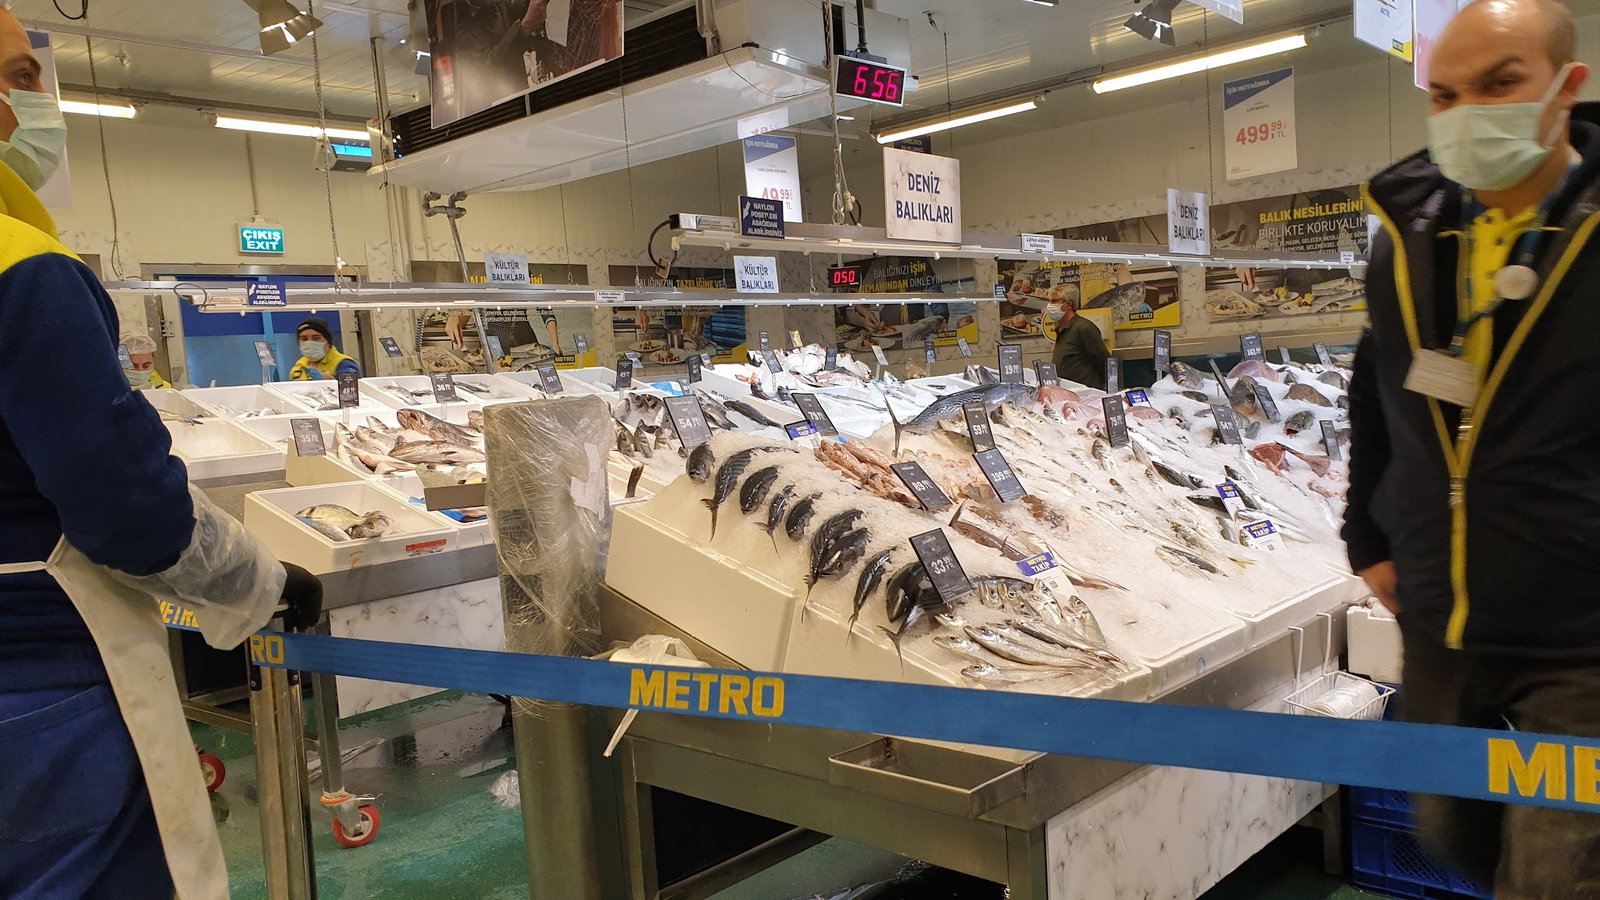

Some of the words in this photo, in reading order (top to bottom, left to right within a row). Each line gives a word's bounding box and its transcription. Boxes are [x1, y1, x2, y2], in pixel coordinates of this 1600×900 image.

[908, 171, 940, 194] DENİZ
[896, 200, 953, 224] BALIKLARI
[1180, 203, 1199, 221] DENİZ
[1259, 209, 1291, 224] BALIK
[1293, 197, 1364, 219] NESİLLERİNİ
[242, 230, 281, 242] ÇIKIŞ
[1174, 224, 1206, 242] BALIKLARI
[247, 241, 279, 250] EXIT
[495, 260, 520, 270] KÜLTÜR
[744, 264, 769, 276] KÜLTÜR
[873, 265, 909, 279] BALIĞINIZI
[910, 261, 926, 276] İŞİN
[492, 273, 526, 282] BALIKLARI
[676, 277, 714, 289] TAZELİĞİNE
[833, 270, 855, 284] 050
[909, 274, 944, 288] DİNLEYİN
[741, 280, 775, 290] BALIKLARI
[931, 559, 947, 575] 33
[1030, 562, 1051, 573] TAKİP
[629, 668, 785, 718] METRO
[1488, 737, 1600, 804] ME
